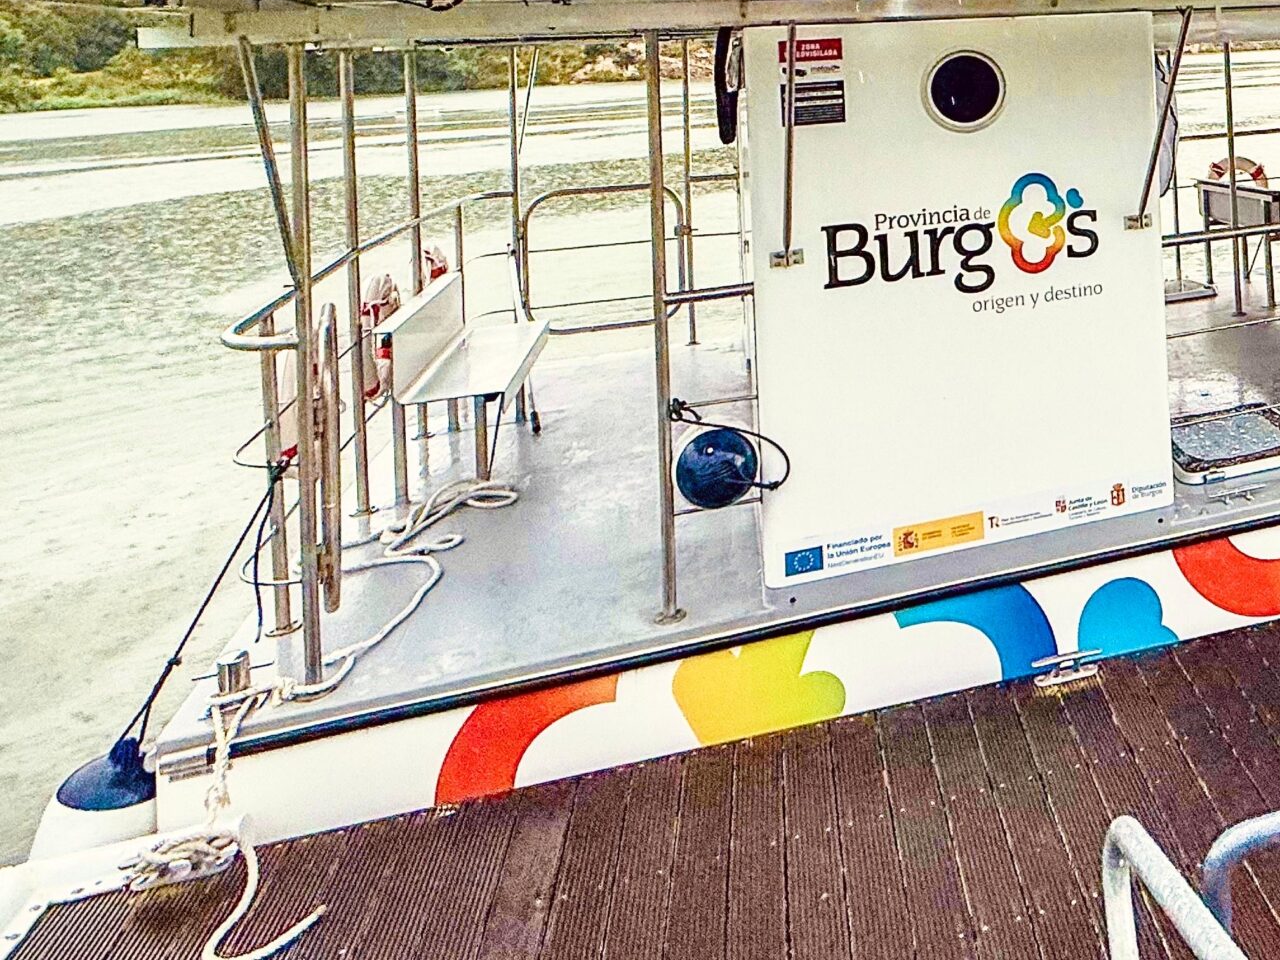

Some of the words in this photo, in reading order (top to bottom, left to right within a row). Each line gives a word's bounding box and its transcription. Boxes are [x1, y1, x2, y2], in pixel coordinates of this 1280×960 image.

[874, 204, 971, 231] Provincia
[973, 206, 991, 221] de
[821, 173, 1099, 294] Burgos
[972, 294, 1025, 314] origen
[1029, 292, 1040, 309] y
[1043, 282, 1103, 303] destino
[827, 537, 868, 550] Financiado
[870, 534, 883, 543] por
[835, 548, 858, 558] Unión
[860, 542, 891, 553] Europea
